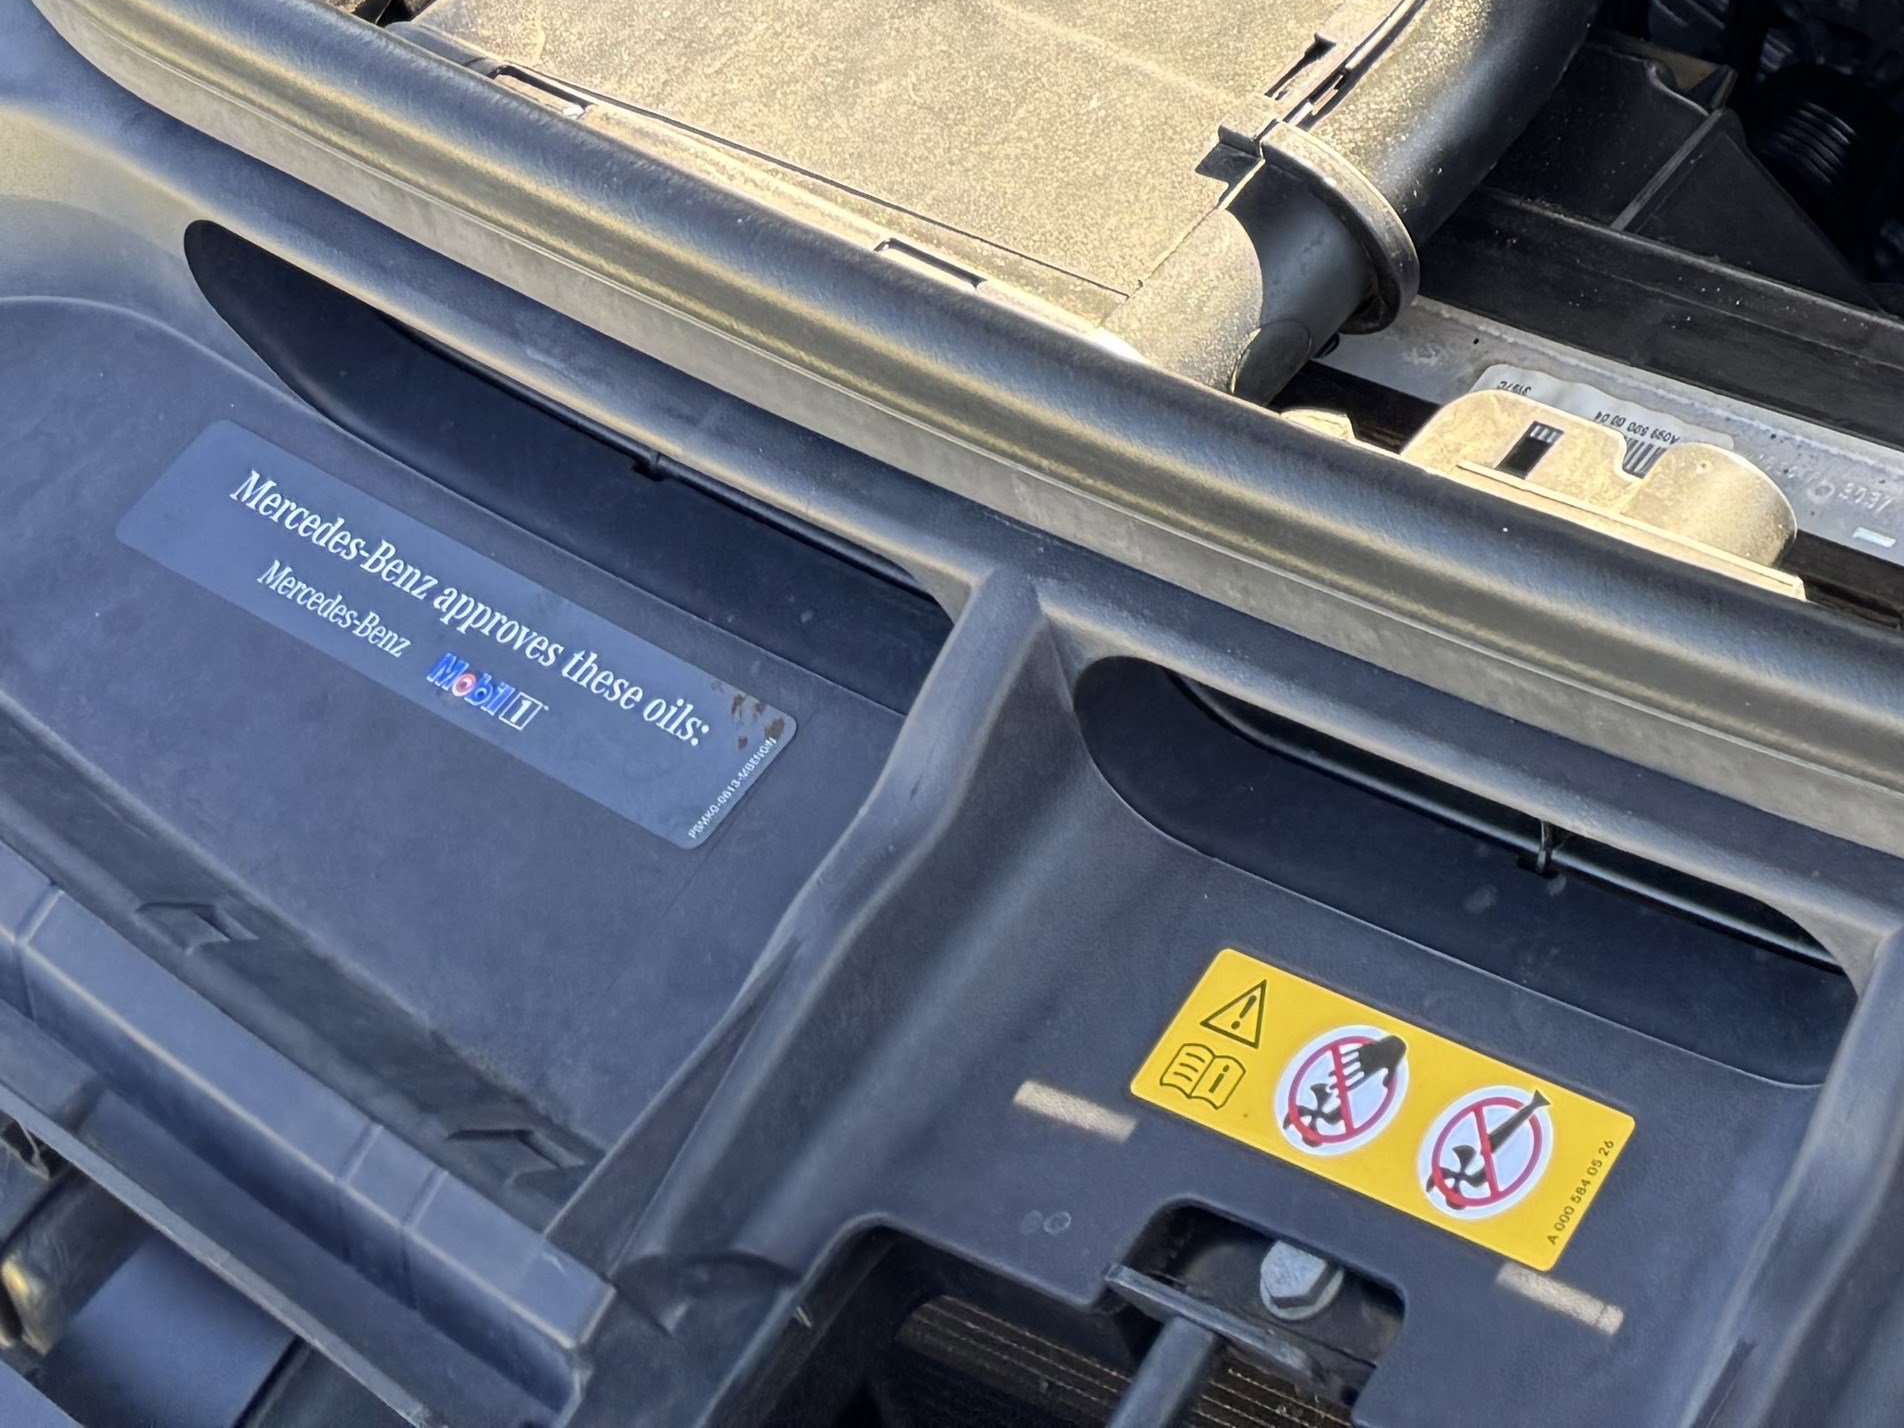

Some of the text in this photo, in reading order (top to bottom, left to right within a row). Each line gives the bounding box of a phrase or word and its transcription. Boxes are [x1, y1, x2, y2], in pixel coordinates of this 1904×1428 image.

[230, 470, 710, 747] Mercedes-Benz approves these oils:
[256, 559, 412, 658] Mercedes-Benz
[426, 651, 516, 721] Mobil
[1545, 1137, 1615, 1245] A 000 584 05 26
